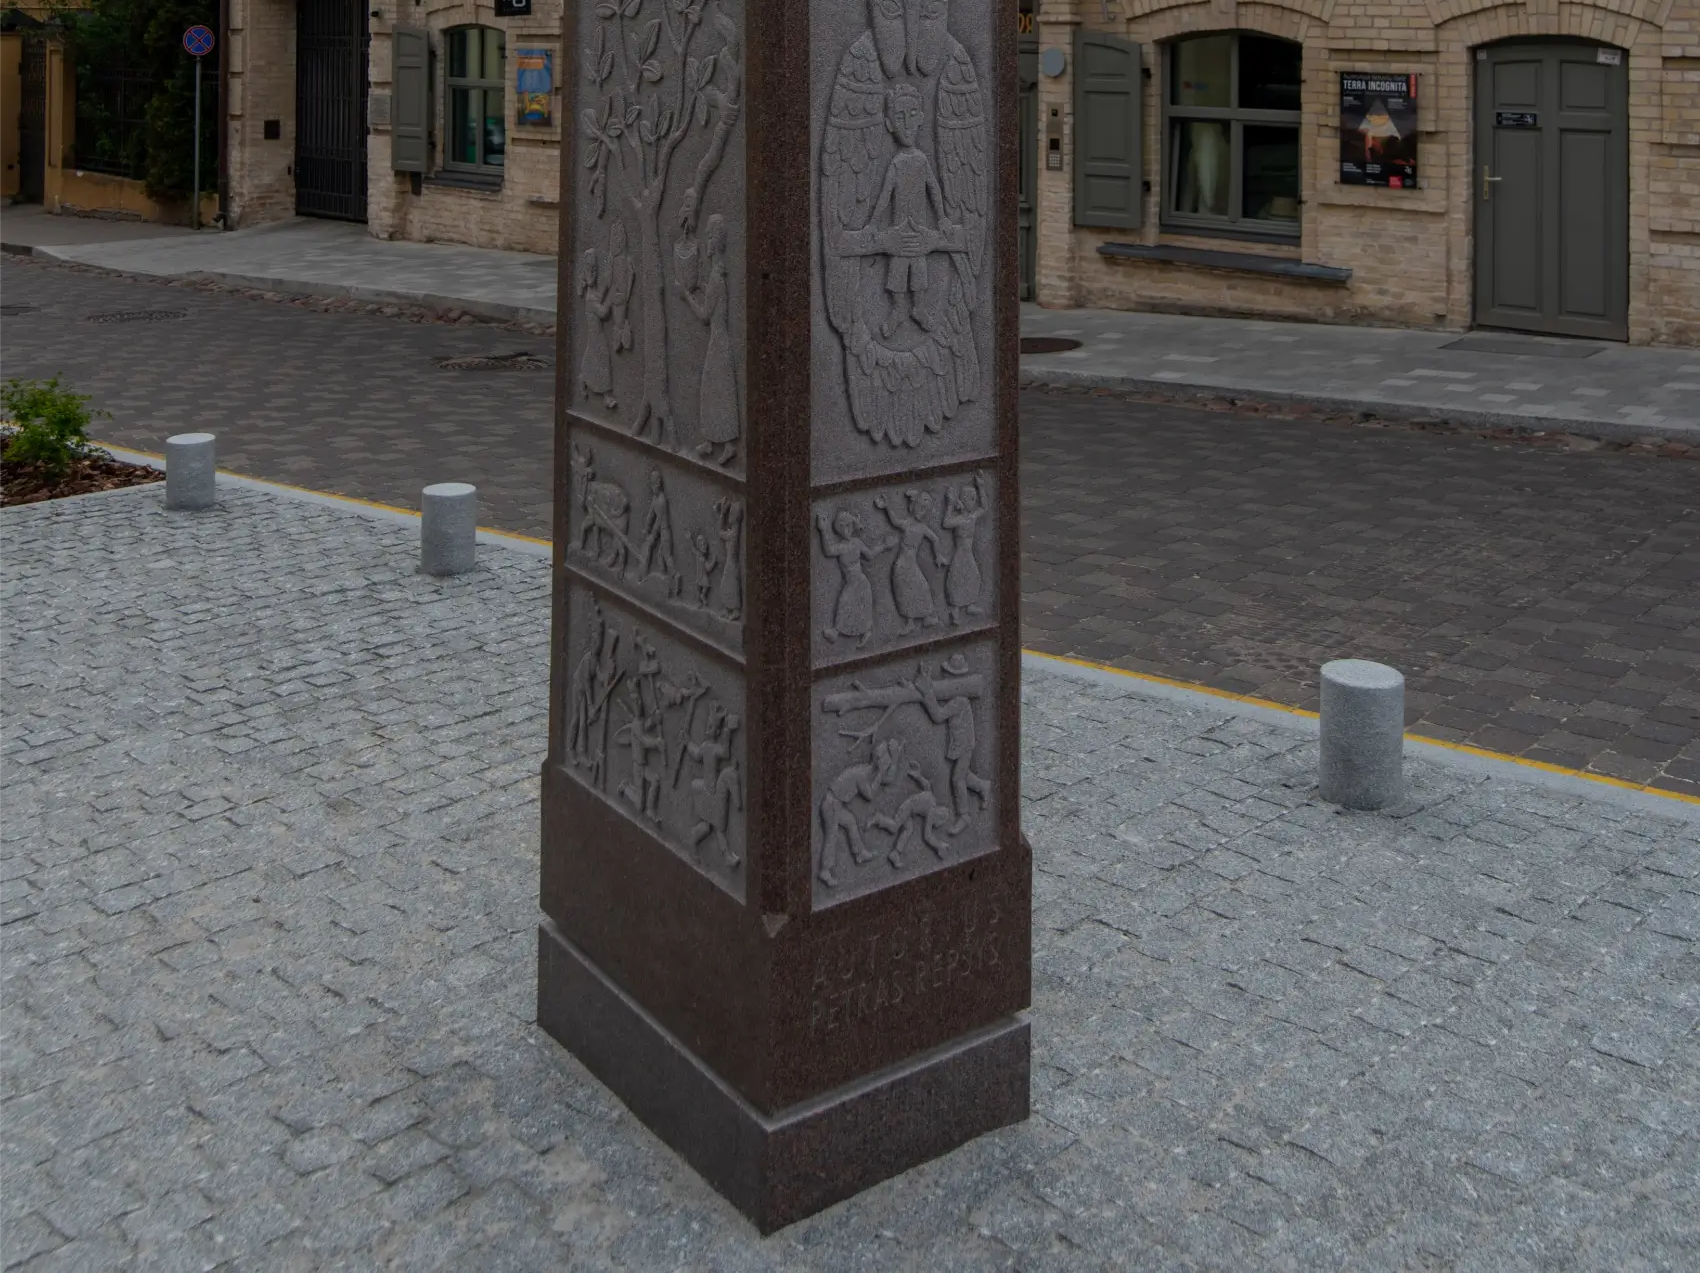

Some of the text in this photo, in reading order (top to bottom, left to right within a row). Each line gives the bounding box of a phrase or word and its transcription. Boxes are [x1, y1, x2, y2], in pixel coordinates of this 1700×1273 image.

[1343, 80, 1366, 90] TERRA
[1367, 81, 1408, 92] INCOGNITA
[811, 969, 904, 1036] PETRAS
